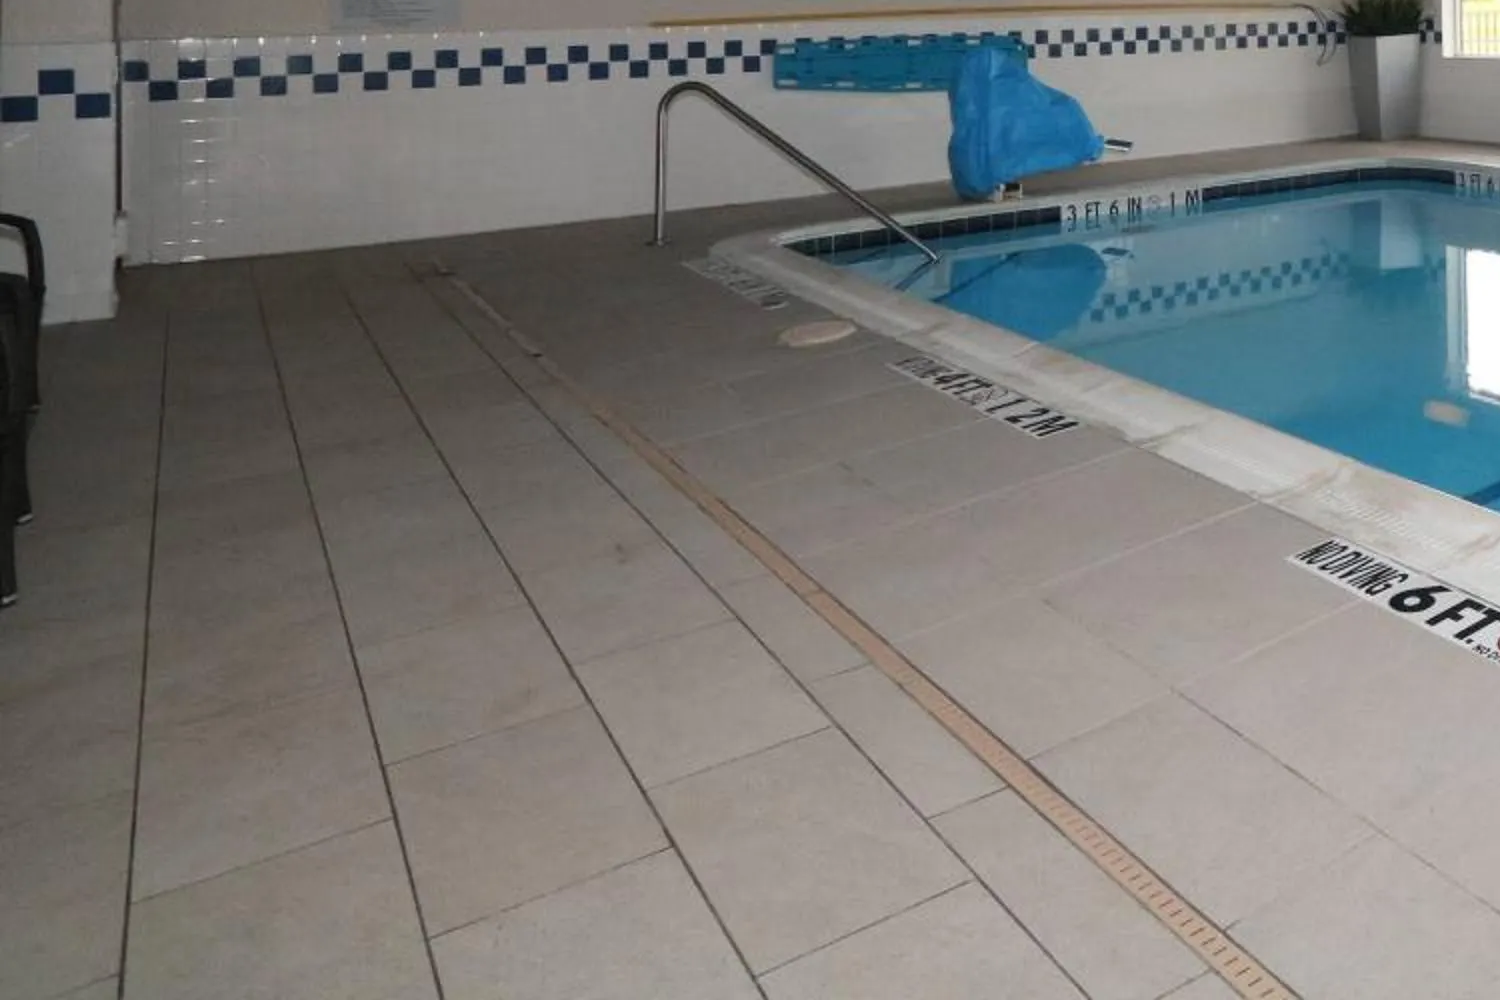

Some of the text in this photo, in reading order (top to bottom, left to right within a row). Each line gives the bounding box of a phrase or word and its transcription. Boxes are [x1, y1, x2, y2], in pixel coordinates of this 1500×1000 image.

[1067, 204, 1077, 221] 3
[1085, 202, 1100, 217] FT
[1109, 200, 1119, 216] 6
[1127, 196, 1142, 214] IN
[1185, 189, 1199, 206] M
[1020, 416, 1080, 437] M
[1294, 540, 1349, 565] NO
[1317, 550, 1409, 596] DIVING
[1388, 584, 1452, 614] 6
